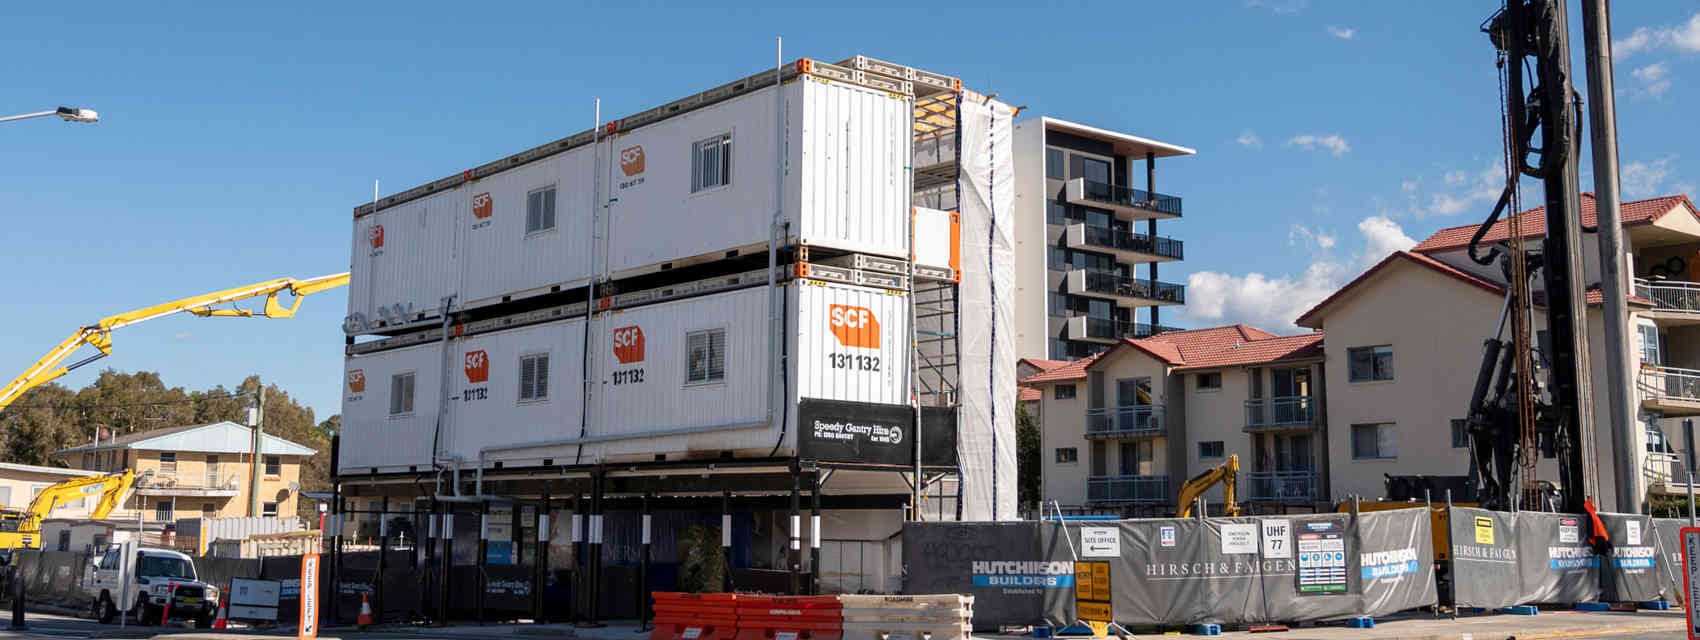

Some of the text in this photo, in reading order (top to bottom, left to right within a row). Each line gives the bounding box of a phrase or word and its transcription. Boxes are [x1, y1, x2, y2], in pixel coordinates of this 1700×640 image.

[832, 307, 869, 328] SCF
[615, 329, 638, 347] SCF
[465, 353, 484, 369] SCF
[829, 352, 880, 372] 131 132
[814, 420, 889, 436] Speedy Gantry Hire
[1266, 526, 1286, 537] UHF
[1271, 540, 1283, 550] 77
[1146, 562, 1216, 576] HIRSCH
[1219, 563, 1230, 574] &
